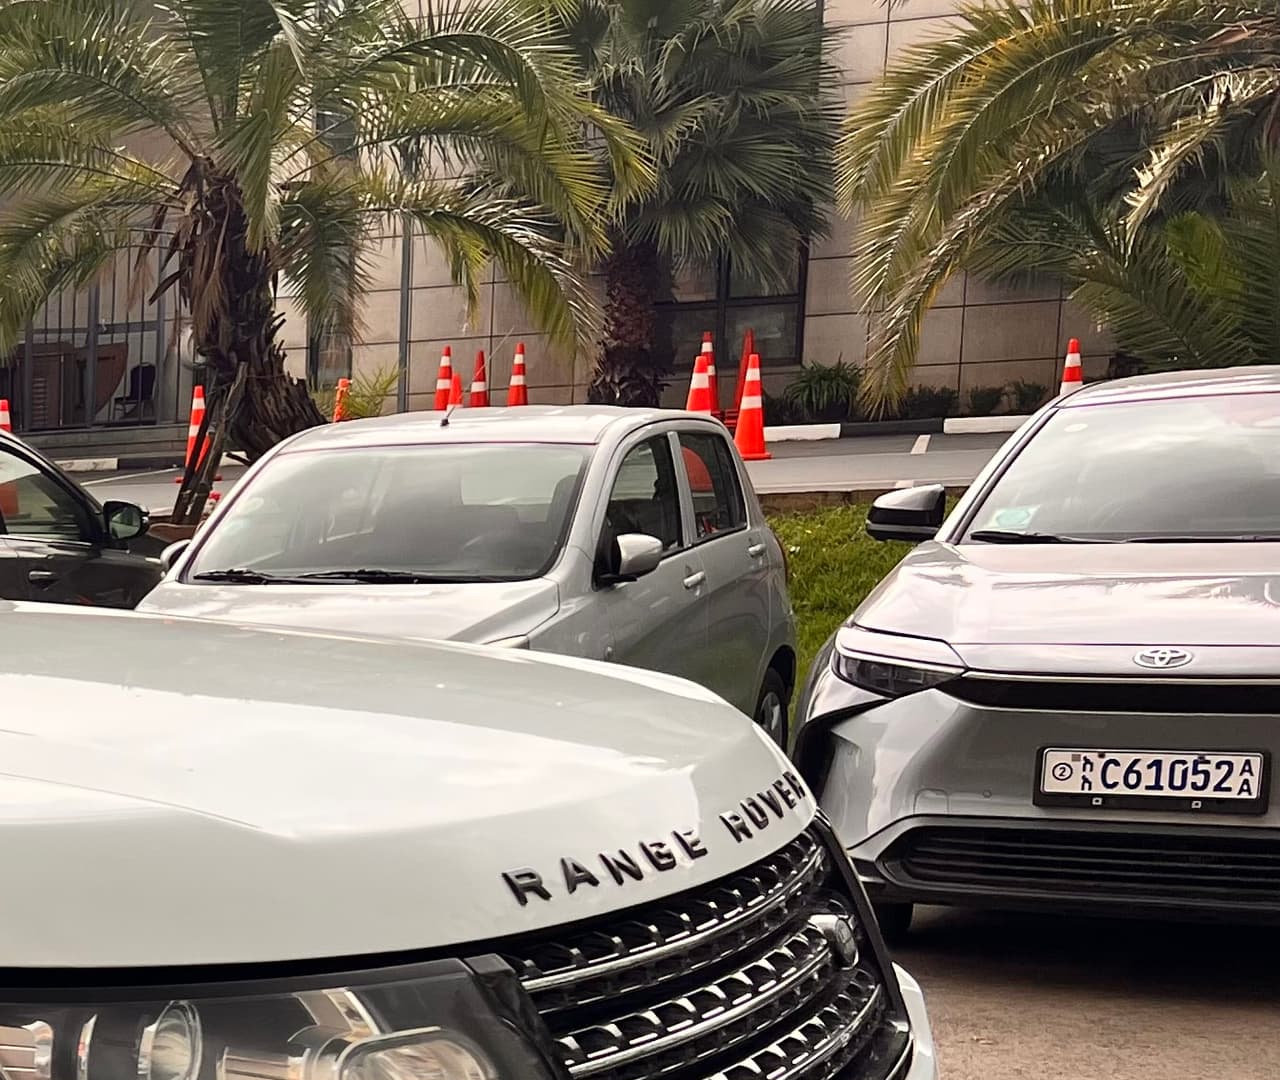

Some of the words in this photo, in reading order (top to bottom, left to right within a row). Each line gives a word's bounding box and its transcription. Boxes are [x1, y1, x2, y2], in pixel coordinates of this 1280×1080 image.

[1100, 758, 1235, 793] C61052
[501, 830, 709, 907] RANGE
[719, 770, 807, 844] ROVER
